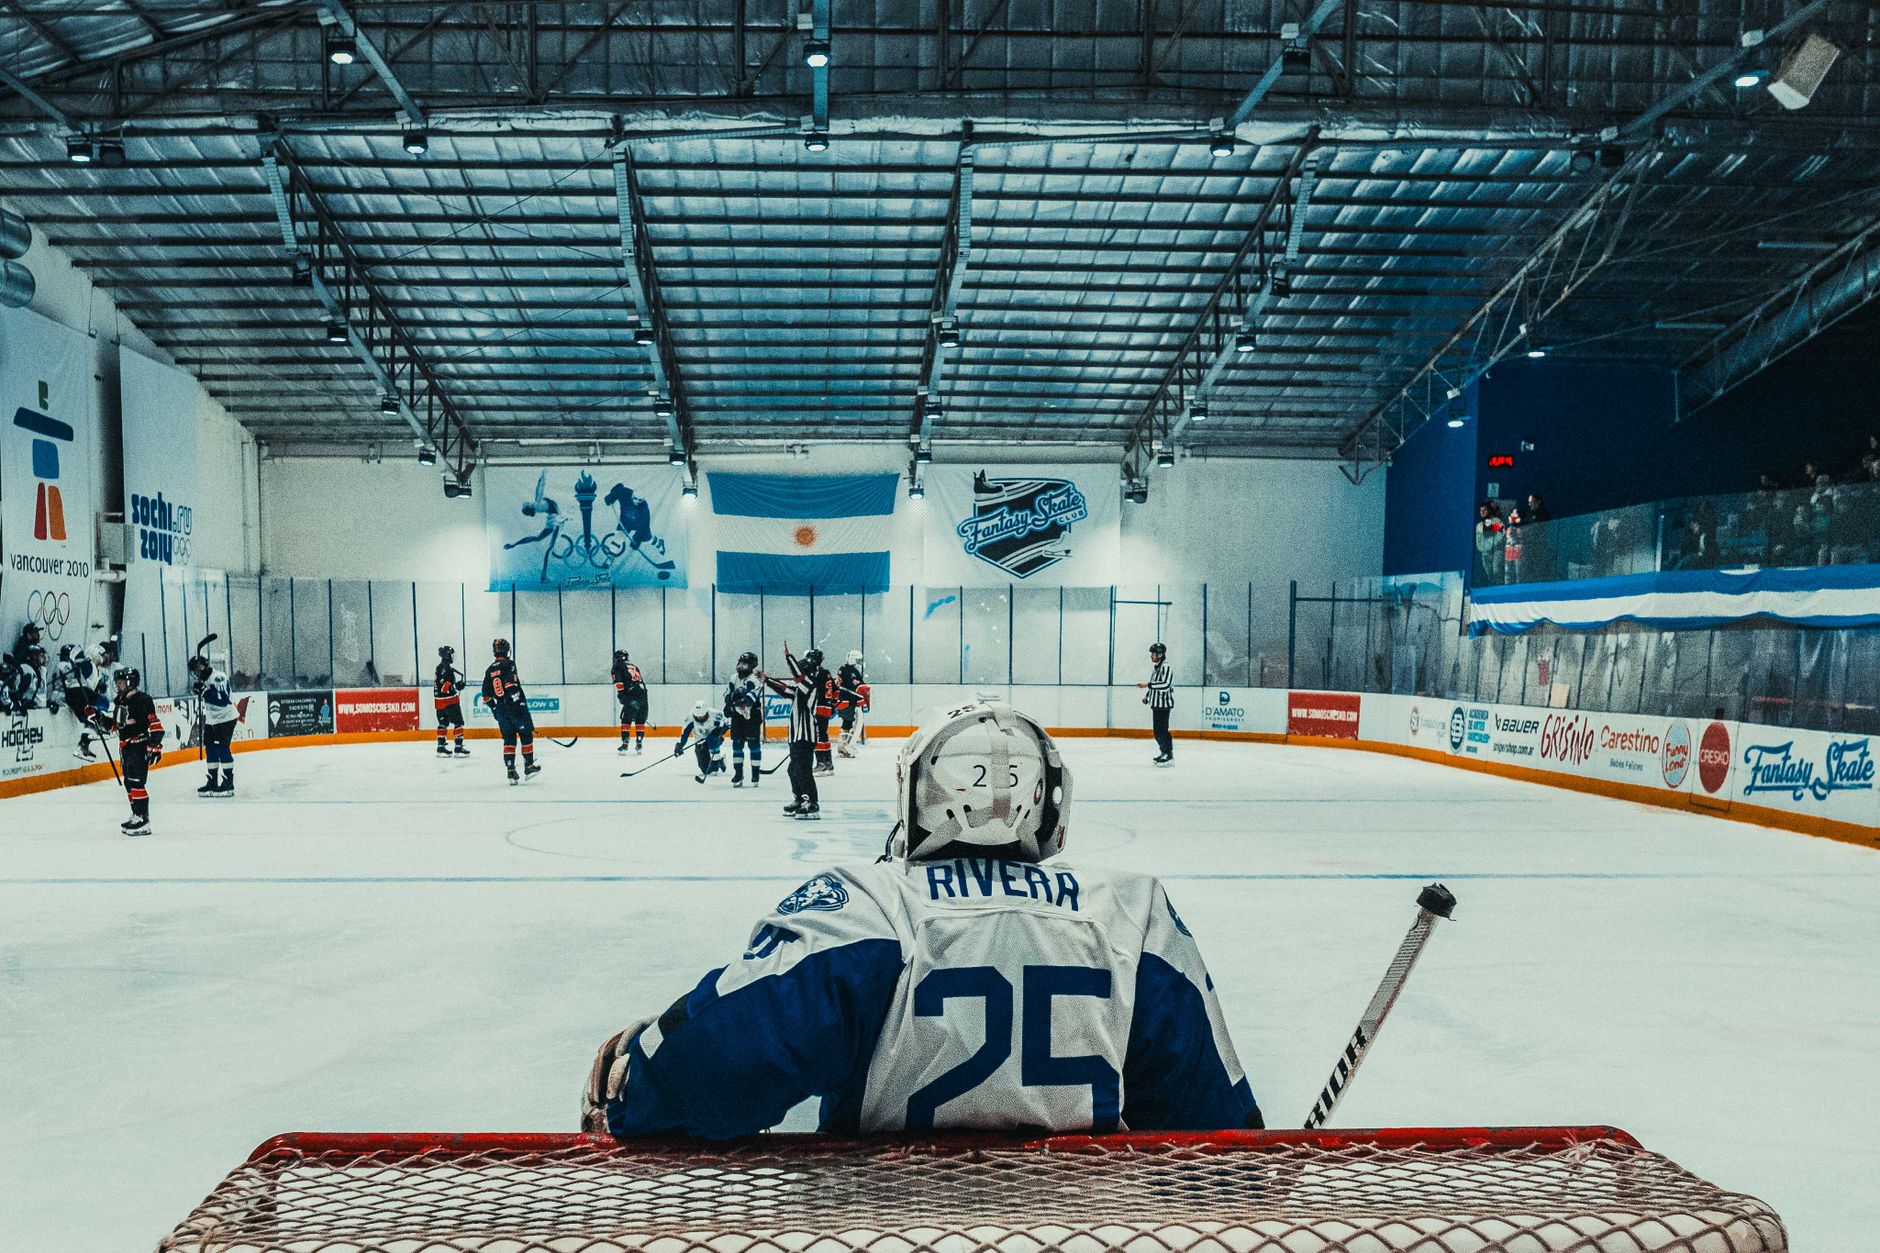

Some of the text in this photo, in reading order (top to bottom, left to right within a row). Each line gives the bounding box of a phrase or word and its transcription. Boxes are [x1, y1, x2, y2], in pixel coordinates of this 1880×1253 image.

[961, 485, 1083, 551] Fantasy Skate
[1059, 509, 1084, 523] CLUB
[10, 553, 89, 578] vancouver 2010
[140, 528, 172, 566] 2014
[947, 705, 976, 719] 25
[1601, 724, 1660, 754] Carestino
[1744, 738, 1875, 801] Fantasy Skate
[926, 858, 1080, 912] RIVERA
[904, 964, 1122, 1130] 25
